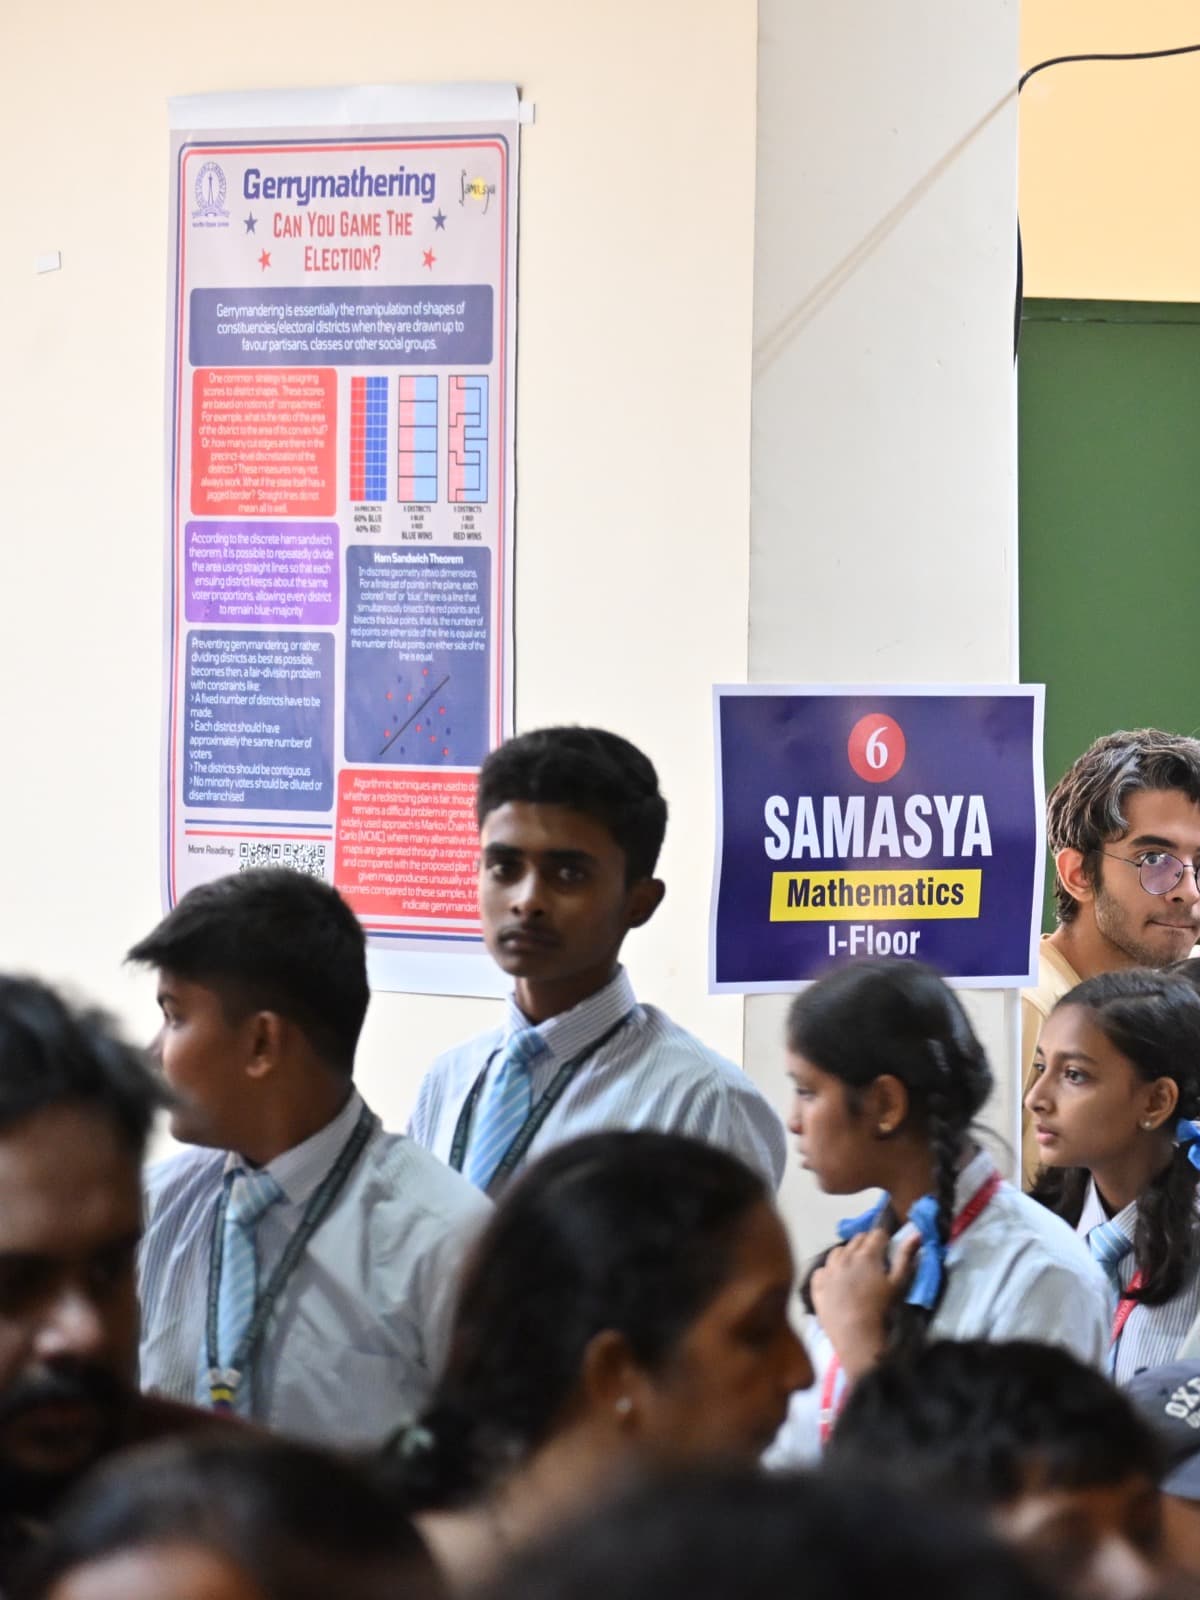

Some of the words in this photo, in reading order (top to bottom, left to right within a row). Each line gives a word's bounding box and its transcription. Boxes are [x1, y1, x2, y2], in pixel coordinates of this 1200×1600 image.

[243, 165, 436, 206] Gerrymathering
[216, 304, 284, 319] Gerrymandering
[285, 303, 292, 316] is
[293, 303, 338, 319] essentially
[340, 303, 354, 315] the
[356, 302, 411, 318] manipulation
[413, 302, 422, 314] of
[423, 302, 454, 317] shapes
[456, 301, 465, 314] of
[217, 321, 314, 333] constituencies/electoral
[316, 320, 350, 333] districts
[352, 320, 376, 332] when
[377, 320, 397, 335] they
[398, 322, 412, 332] are
[413, 319, 440, 332] drawn
[442, 322, 453, 335] up
[455, 319, 464, 332] to
[242, 338, 267, 350] favour
[310, 338, 342, 350] classes
[344, 340, 353, 350] or
[355, 337, 377, 350] other
[378, 337, 403, 350] social
[374, 553, 391, 564] Ham
[392, 553, 428, 564] Sandwich
[429, 553, 464, 564] Theorem
[191, 638, 230, 652] Preventing
[290, 642, 298, 650] or
[191, 651, 219, 665] dividing
[220, 652, 247, 663] districts
[247, 655, 256, 663] as
[257, 653, 273, 664] best
[274, 656, 282, 664] as
[191, 665, 224, 676] becomes
[244, 669, 249, 677] a
[249, 667, 290, 678] fair-division
[290, 668, 321, 681] problem
[190, 679, 206, 690] with
[207, 679, 246, 690] constraints
[194, 693, 201, 704] A
[201, 693, 219, 704] fixed
[220, 693, 247, 704] number
[248, 694, 256, 705] of
[257, 694, 284, 705] districts
[285, 695, 302, 706] have
[303, 695, 311, 706] to
[311, 695, 320, 706] be
[194, 721, 212, 732] Each
[213, 721, 237, 732] district
[238, 722, 261, 733] should
[262, 722, 280, 733] have
[190, 735, 240, 749] approximately
[241, 736, 252, 747] the
[253, 739, 274, 747] same
[275, 737, 302, 748] number
[303, 737, 312, 748] of
[866, 726, 888, 768] 6
[189, 748, 212, 759] voters
[194, 762, 207, 773] The
[208, 763, 235, 774] districts
[236, 764, 259, 775] should
[260, 764, 270, 775] be
[271, 765, 310, 778] contiguous
[193, 776, 204, 787] No
[205, 776, 234, 790] minority
[235, 777, 255, 788] votes
[255, 778, 279, 789] should
[280, 778, 288, 789] be
[290, 779, 314, 790] diluted
[315, 782, 322, 790] or
[764, 794, 993, 860] SAMASYA
[787, 877, 964, 907] Mathematics
[829, 924, 920, 956] I-Floor
